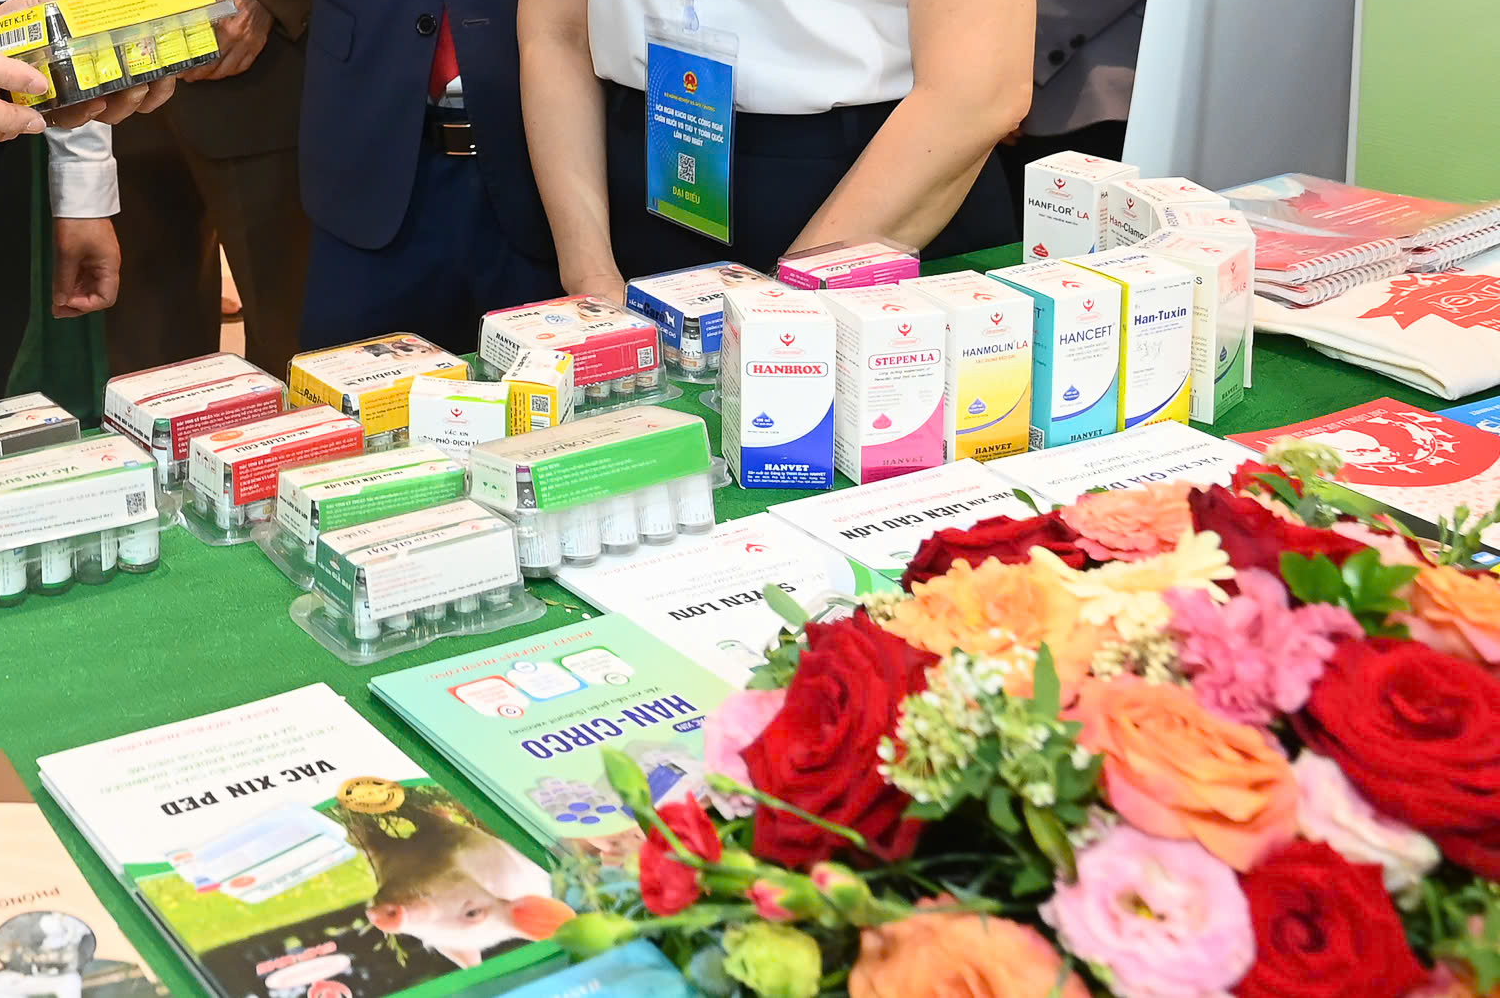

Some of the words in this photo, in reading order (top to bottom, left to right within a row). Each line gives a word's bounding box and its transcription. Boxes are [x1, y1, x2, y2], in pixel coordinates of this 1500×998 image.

[672, 185, 685, 199] ĐẠI
[685, 188, 701, 205] BIỂU
[1076, 210, 1090, 221] LA
[1134, 307, 1187, 326] Han-Tuxin
[495, 332, 521, 351] HANVET
[1016, 340, 1028, 350] LA
[874, 355, 917, 366] STEPEN
[920, 353, 934, 362] LA
[752, 364, 822, 375] HANBROX
[1070, 429, 1103, 441] HANVET
[975, 443, 1012, 455] HANVET
[53, 464, 79, 475] VẮC
[764, 463, 810, 472] HANVET
[882, 456, 924, 466] HANVET
[1166, 461, 1192, 476] XIN
[1192, 452, 1224, 471] VẮC
[26, 469, 50, 480] XIN
[966, 495, 988, 509] XIN
[921, 498, 970, 526] LIÊN
[881, 510, 924, 535] CẦU
[838, 520, 882, 545] LỢN
[718, 582, 797, 613] SYỄN
[668, 599, 711, 623] LỢN
[521, 694, 699, 760] HAN-CIRCO
[225, 773, 277, 801] XIN
[160, 790, 220, 816] PED
